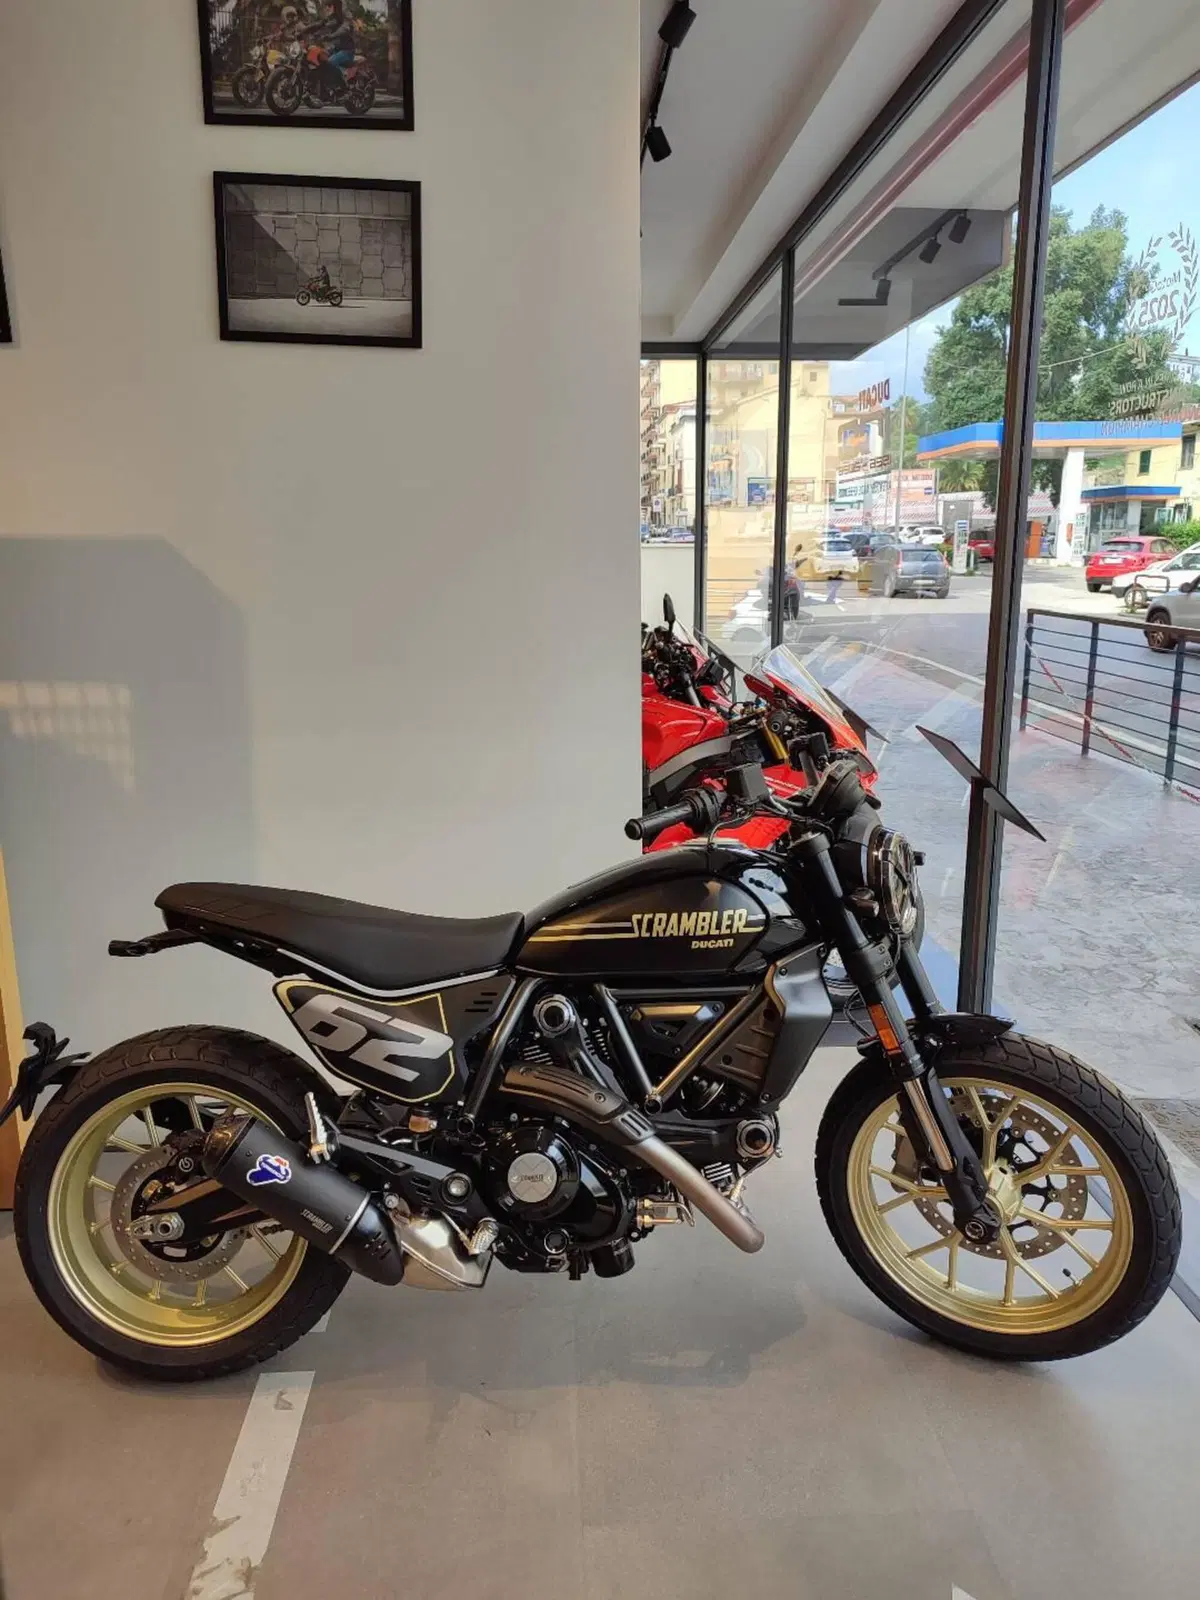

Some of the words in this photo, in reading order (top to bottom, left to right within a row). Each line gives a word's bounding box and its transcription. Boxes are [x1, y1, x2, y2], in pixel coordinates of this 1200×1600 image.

[632, 908, 748, 938] SCRAMBLER
[691, 938, 734, 949] DUCATI
[291, 993, 454, 1082] 62
